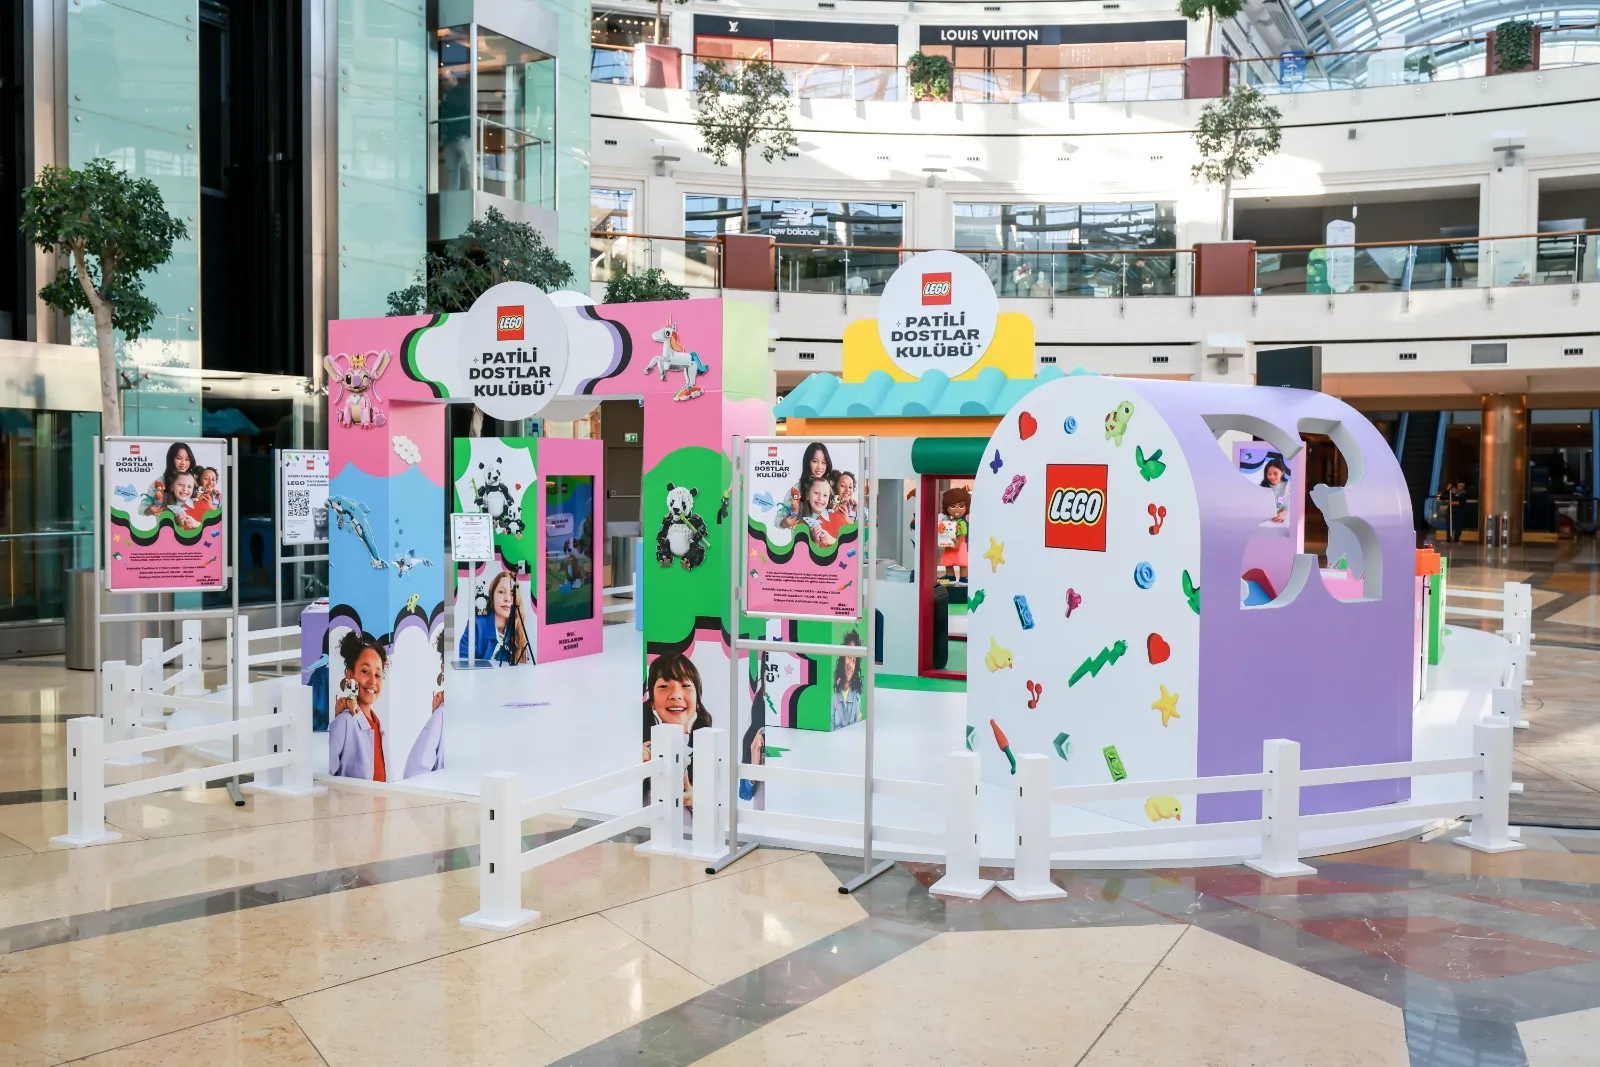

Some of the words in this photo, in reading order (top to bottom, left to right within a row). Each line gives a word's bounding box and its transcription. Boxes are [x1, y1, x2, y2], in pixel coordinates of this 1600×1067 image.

[940, 29, 979, 41] LOUIS
[982, 29, 1039, 41] VUITTON
[786, 227, 820, 236] balance
[922, 281, 951, 297] LEGO
[499, 315, 523, 331] LEGO
[905, 311, 965, 328] PATİLİ
[891, 329, 980, 342] DOSTLAR
[482, 346, 538, 364] PATİLİ
[896, 342, 973, 358] KULÜBÜ
[469, 366, 551, 380] DOSTLAR
[474, 380, 546, 397] KULÜBÜ
[1048, 487, 1104, 526] LEGO
